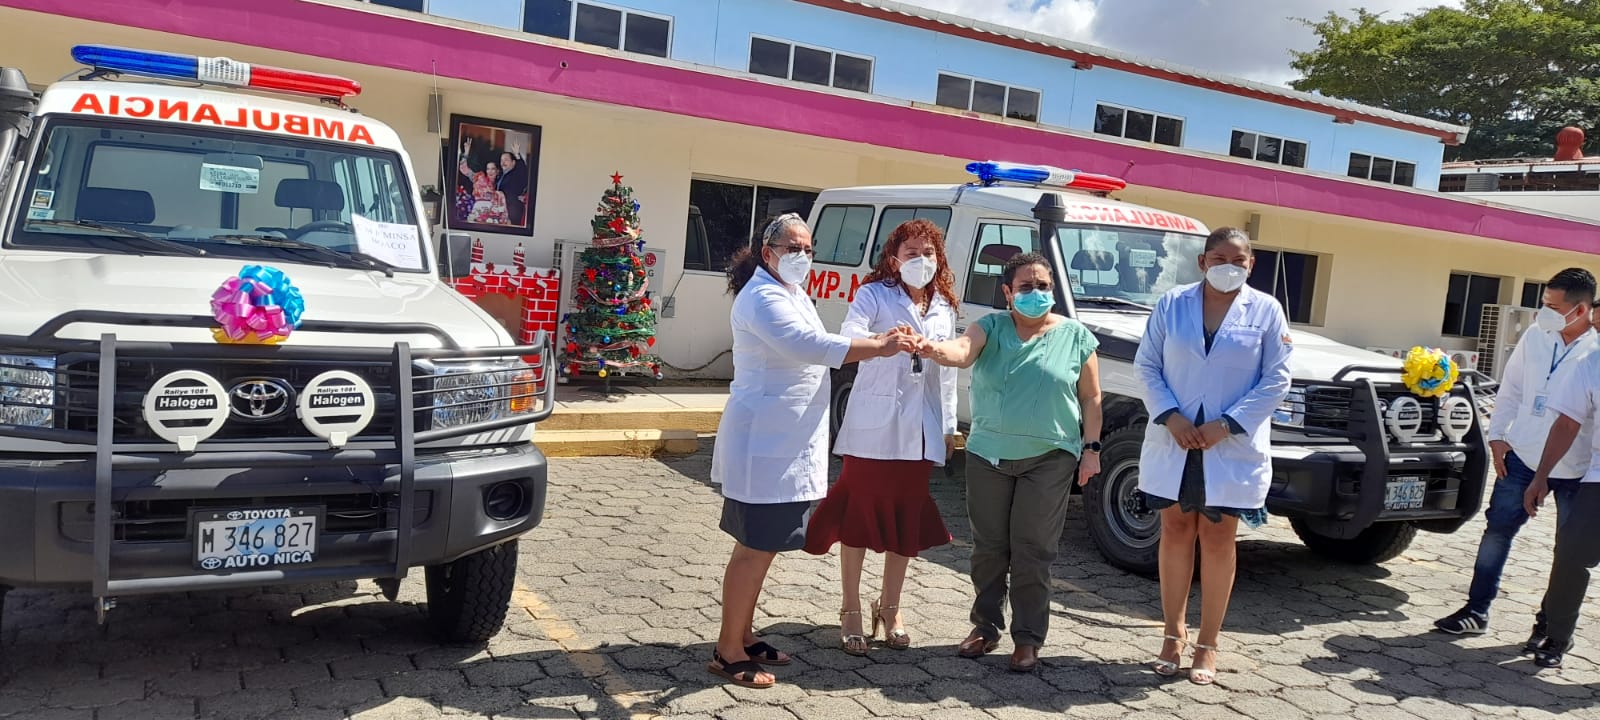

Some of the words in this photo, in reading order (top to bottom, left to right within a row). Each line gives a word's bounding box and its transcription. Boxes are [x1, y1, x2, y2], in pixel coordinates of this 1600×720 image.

[159, 396, 214, 409] Halogen
[313, 395, 361, 406] Halogen
[242, 509, 291, 519] TOYOTA
[202, 528, 214, 553] M
[224, 526, 265, 552] 346
[274, 522, 313, 548] 827
[224, 554, 269, 568] AUTO
[273, 551, 313, 564] NICA
